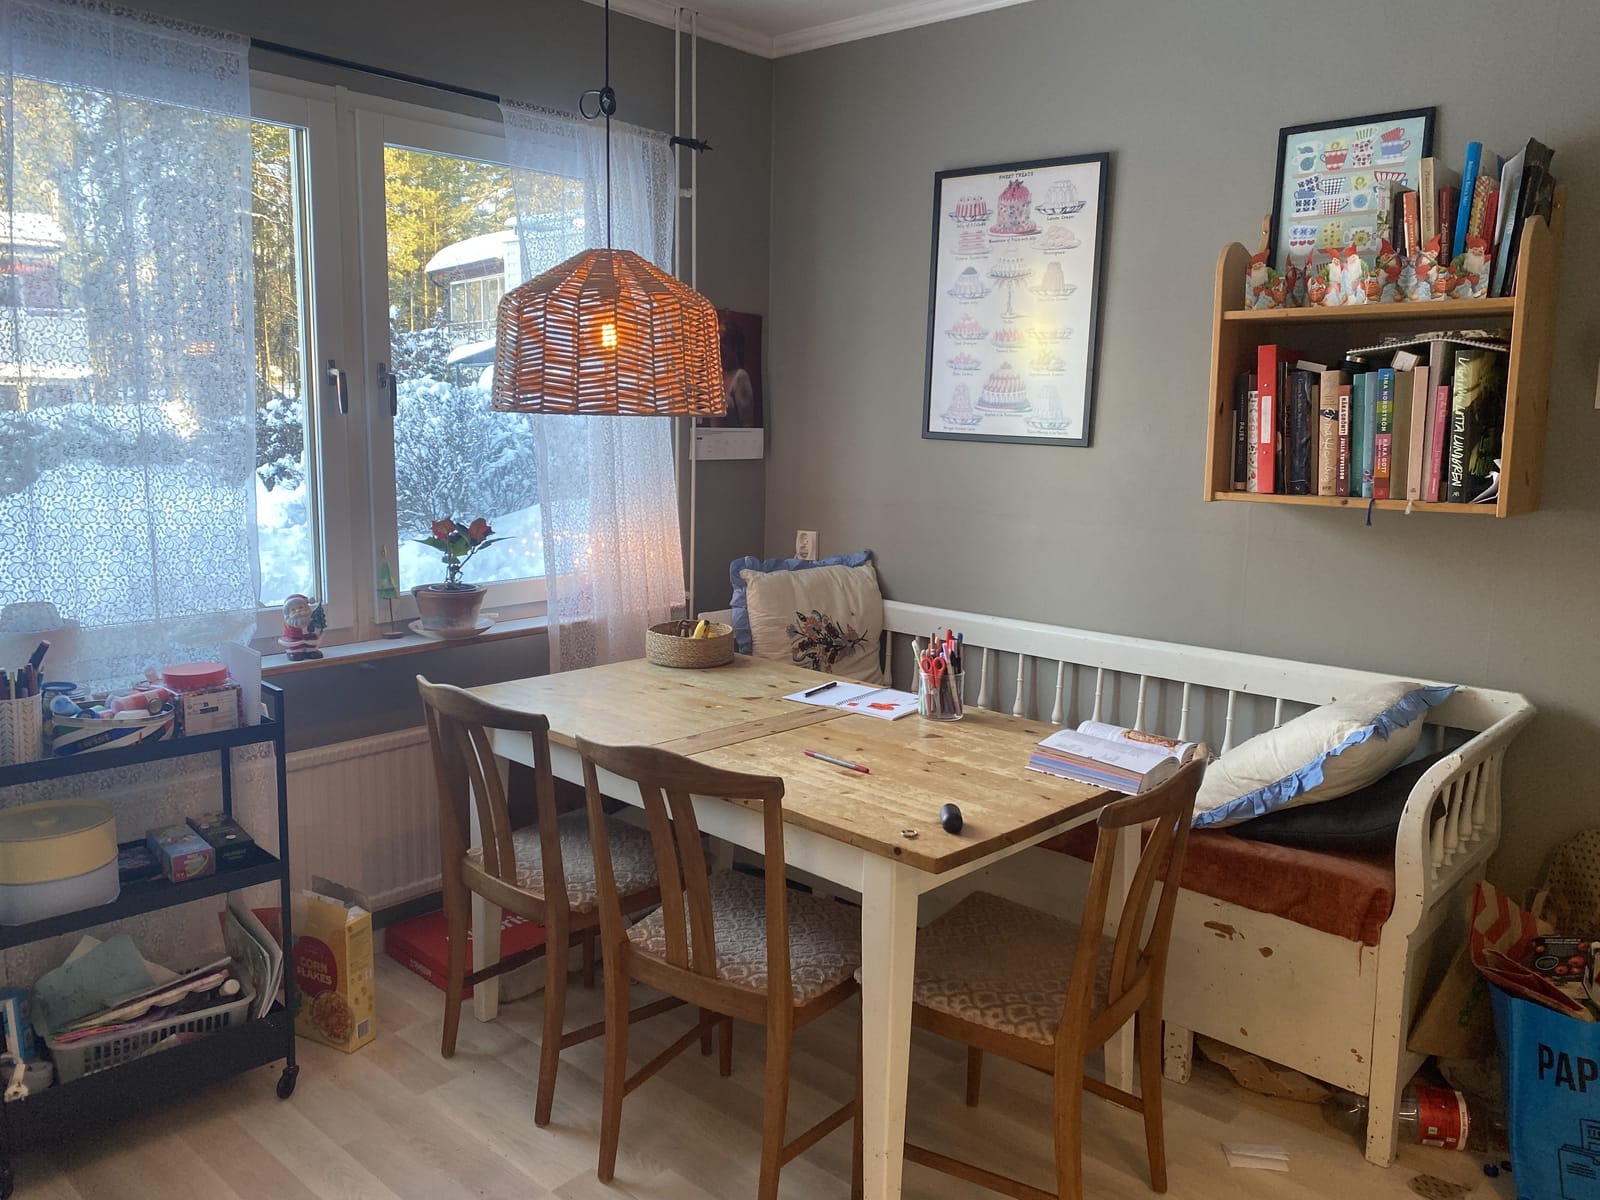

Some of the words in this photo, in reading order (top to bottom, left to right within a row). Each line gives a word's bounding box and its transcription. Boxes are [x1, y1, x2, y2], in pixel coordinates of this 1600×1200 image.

[1451, 434, 1464, 487] LUNDGREN
[297, 966, 333, 985] FLAKES
[300, 956, 328, 974] CORN
[1537, 1041, 1598, 1093] PAP
